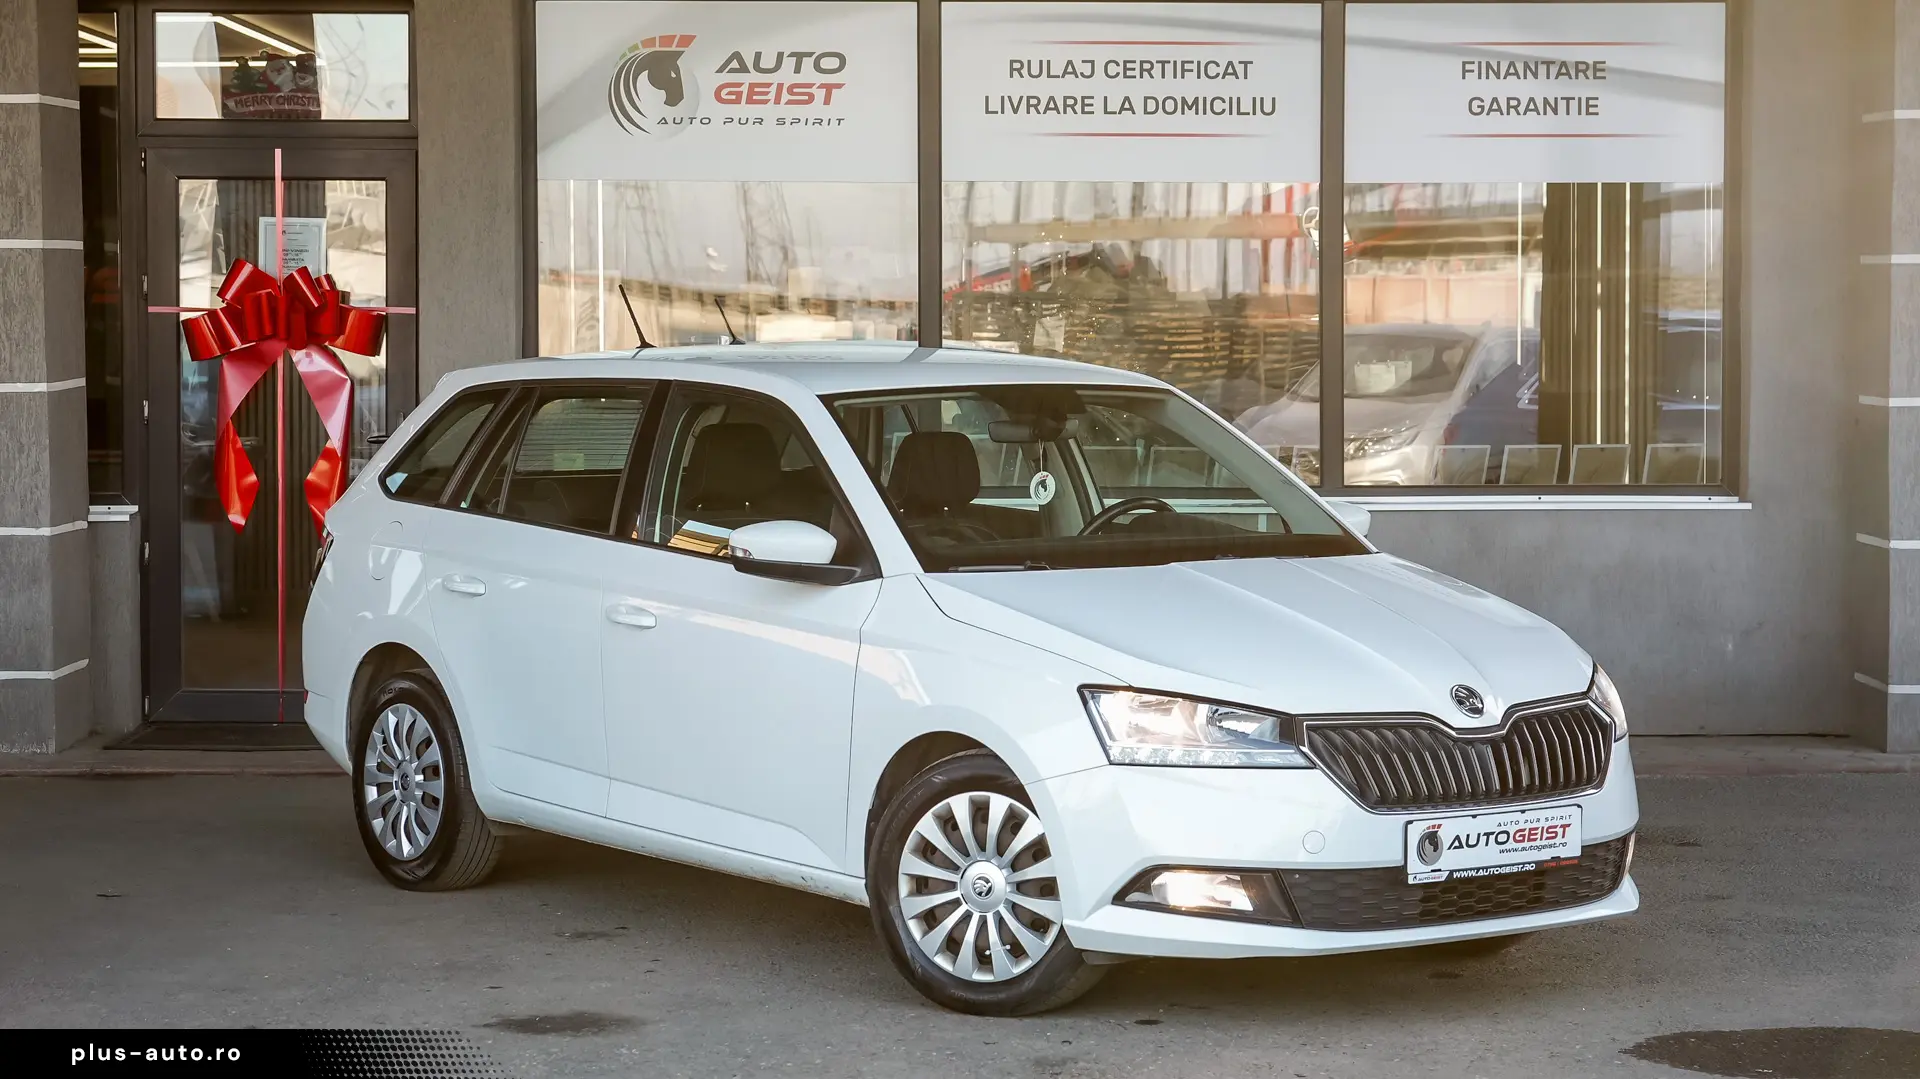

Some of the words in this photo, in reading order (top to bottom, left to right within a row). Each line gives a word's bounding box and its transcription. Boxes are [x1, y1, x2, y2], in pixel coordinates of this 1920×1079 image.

[714, 50, 847, 75] AUTO
[1009, 59, 1096, 79] RULAJ
[1103, 59, 1254, 80] CERTIFICAT
[1461, 60, 1607, 80] FINANTARE
[234, 95, 273, 108] MERRY
[713, 82, 847, 106] GEIST
[984, 95, 1095, 115] LIVRARE
[1103, 95, 1136, 115] LA
[1143, 96, 1277, 116] DOMICILIU
[1468, 96, 1600, 116] GARANTIE
[656, 116, 712, 125] AUTO
[723, 117, 764, 126] PUR
[775, 117, 846, 127] SPIRIT
[1496, 820, 1520, 828] AUTO
[1545, 814, 1573, 823] SPIRIT
[1446, 823, 1572, 850] AUTOGEIST
[1499, 841, 1568, 854] www.autogeist.ro
[1452, 863, 1536, 879] WWW.AUTOGEIST.RO
